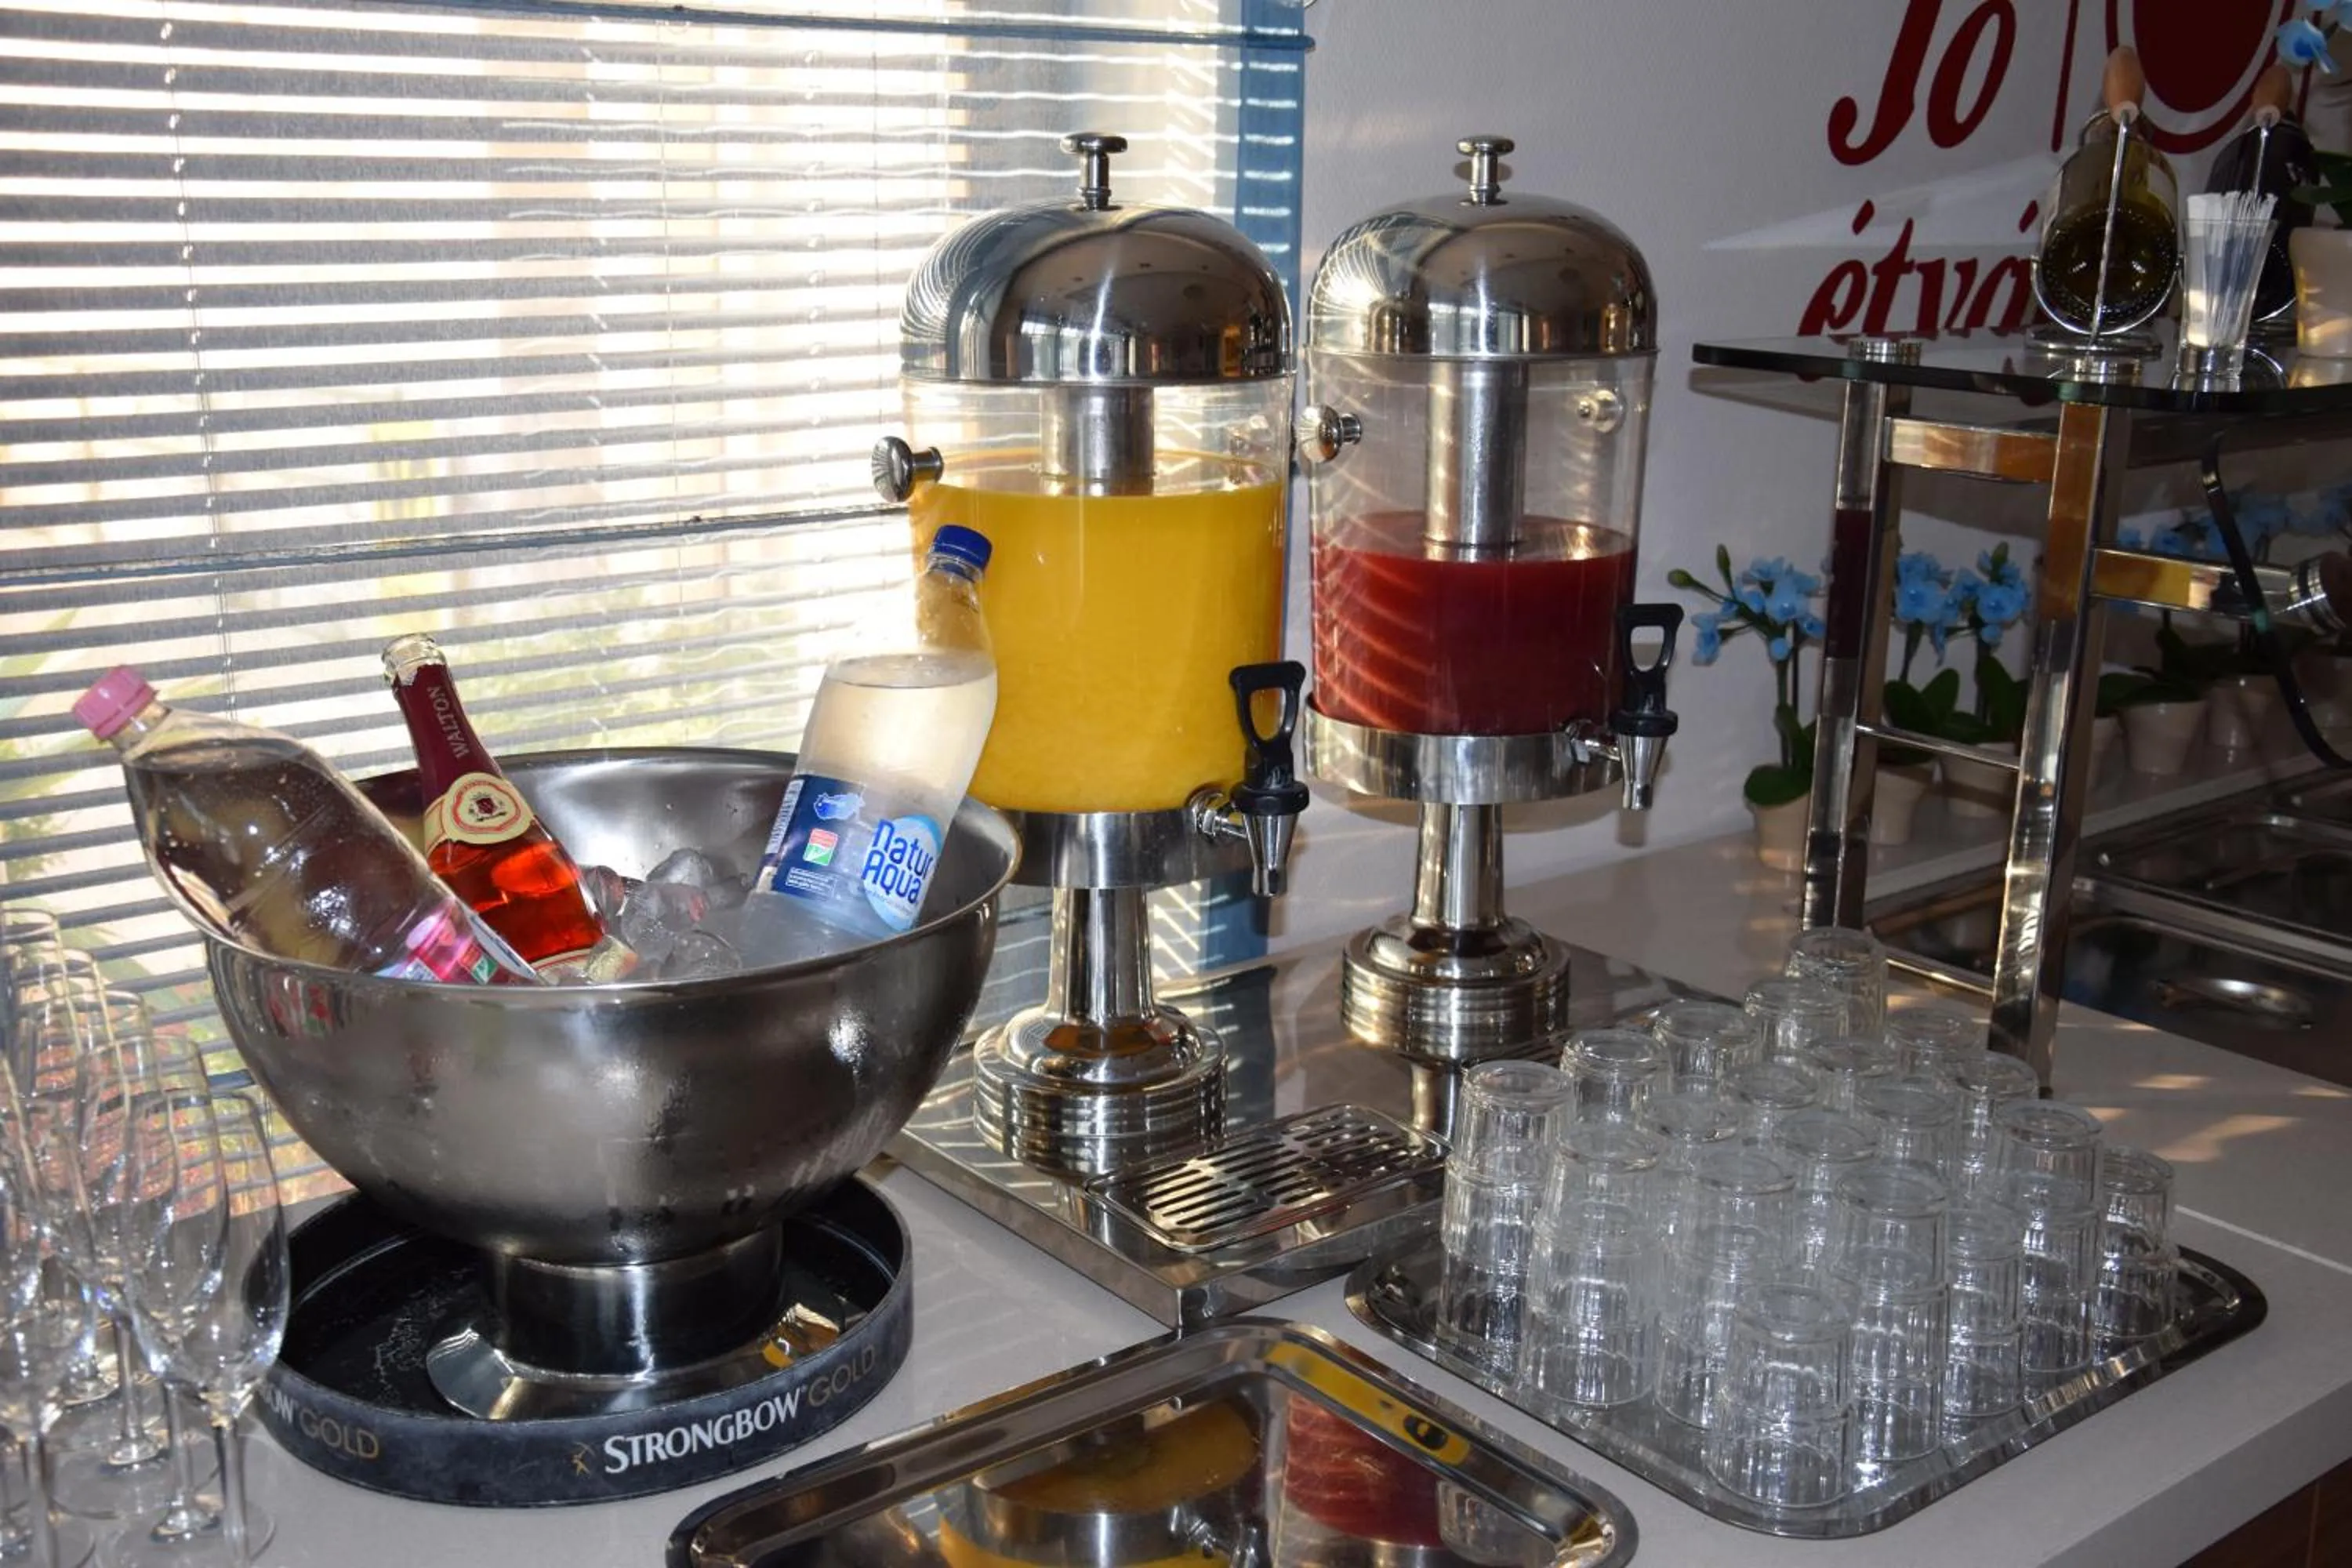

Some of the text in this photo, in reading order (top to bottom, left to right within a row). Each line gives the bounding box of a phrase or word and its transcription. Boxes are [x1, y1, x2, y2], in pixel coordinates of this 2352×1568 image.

[427, 685, 470, 758] WALTON
[299, 1407, 379, 1459] GOLD
[603, 1345, 874, 1474] STRONGBOW GOLD
